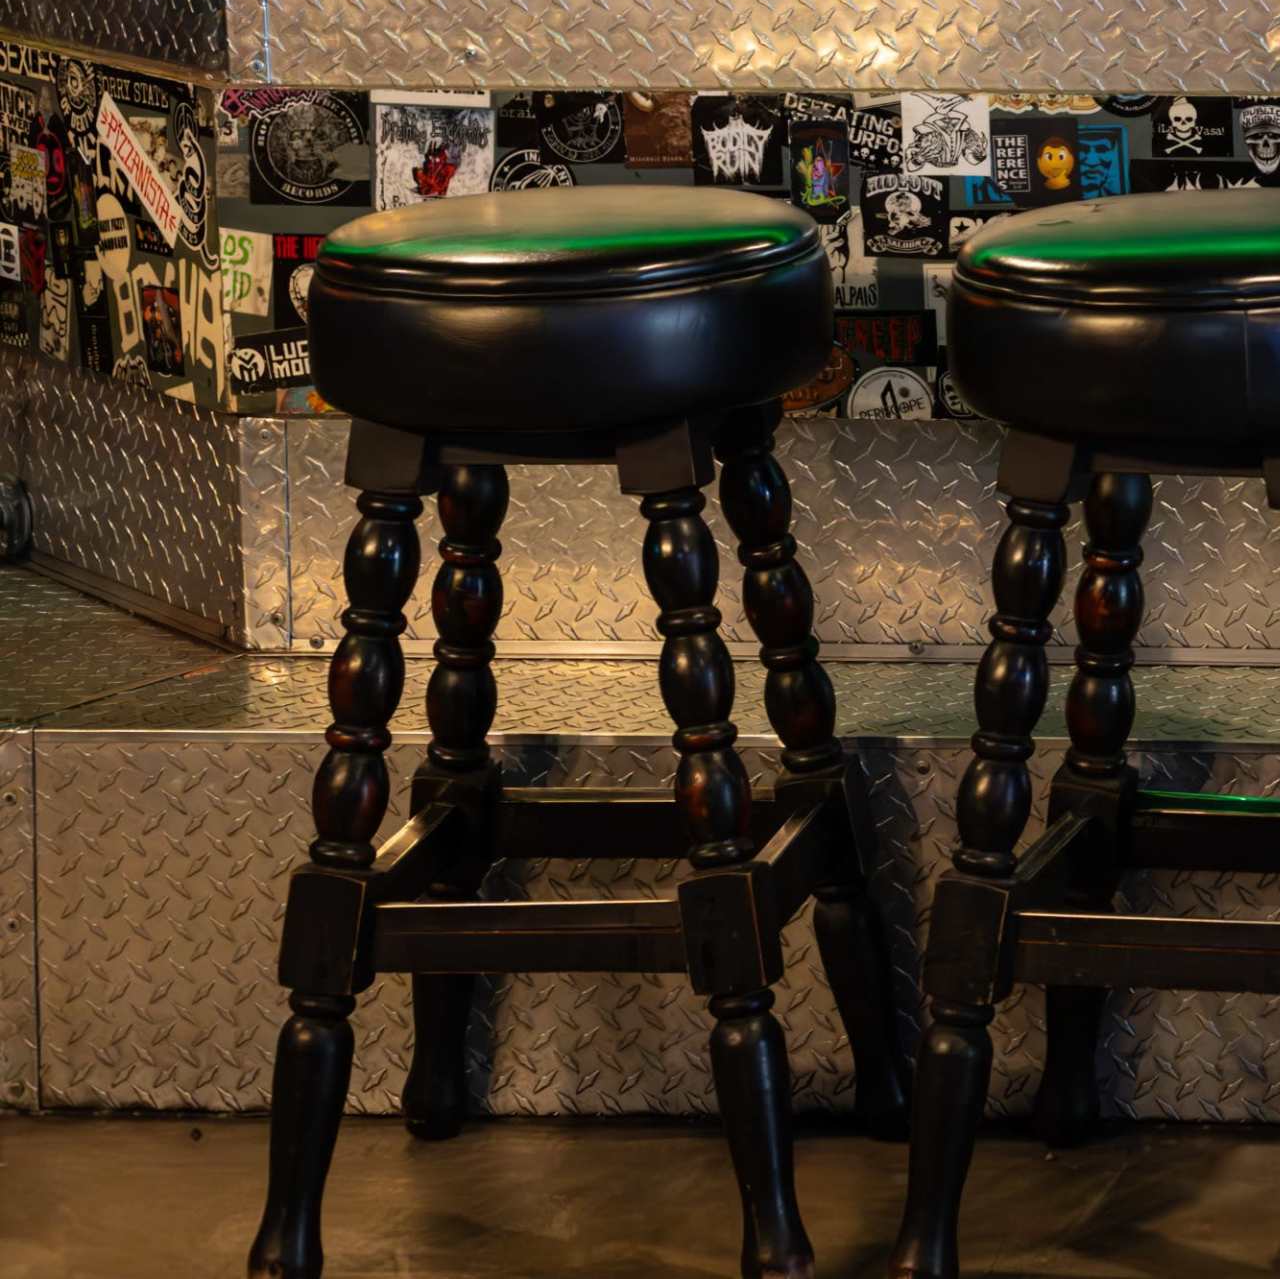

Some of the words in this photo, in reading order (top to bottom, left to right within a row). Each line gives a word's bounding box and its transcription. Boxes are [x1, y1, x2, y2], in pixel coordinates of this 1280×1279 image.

[133, 81, 169, 110] STATE
[784, 92, 894, 137] DEFEATING
[700, 125, 772, 154] BODILY
[996, 137, 1026, 147] THE
[996, 148, 1025, 158] REF
[996, 159, 1027, 169] ERE
[708, 150, 762, 184] RUIN
[997, 169, 1028, 180] NCE
[281, 181, 341, 198] RECORDS
[866, 174, 944, 201] HIDEOUT
